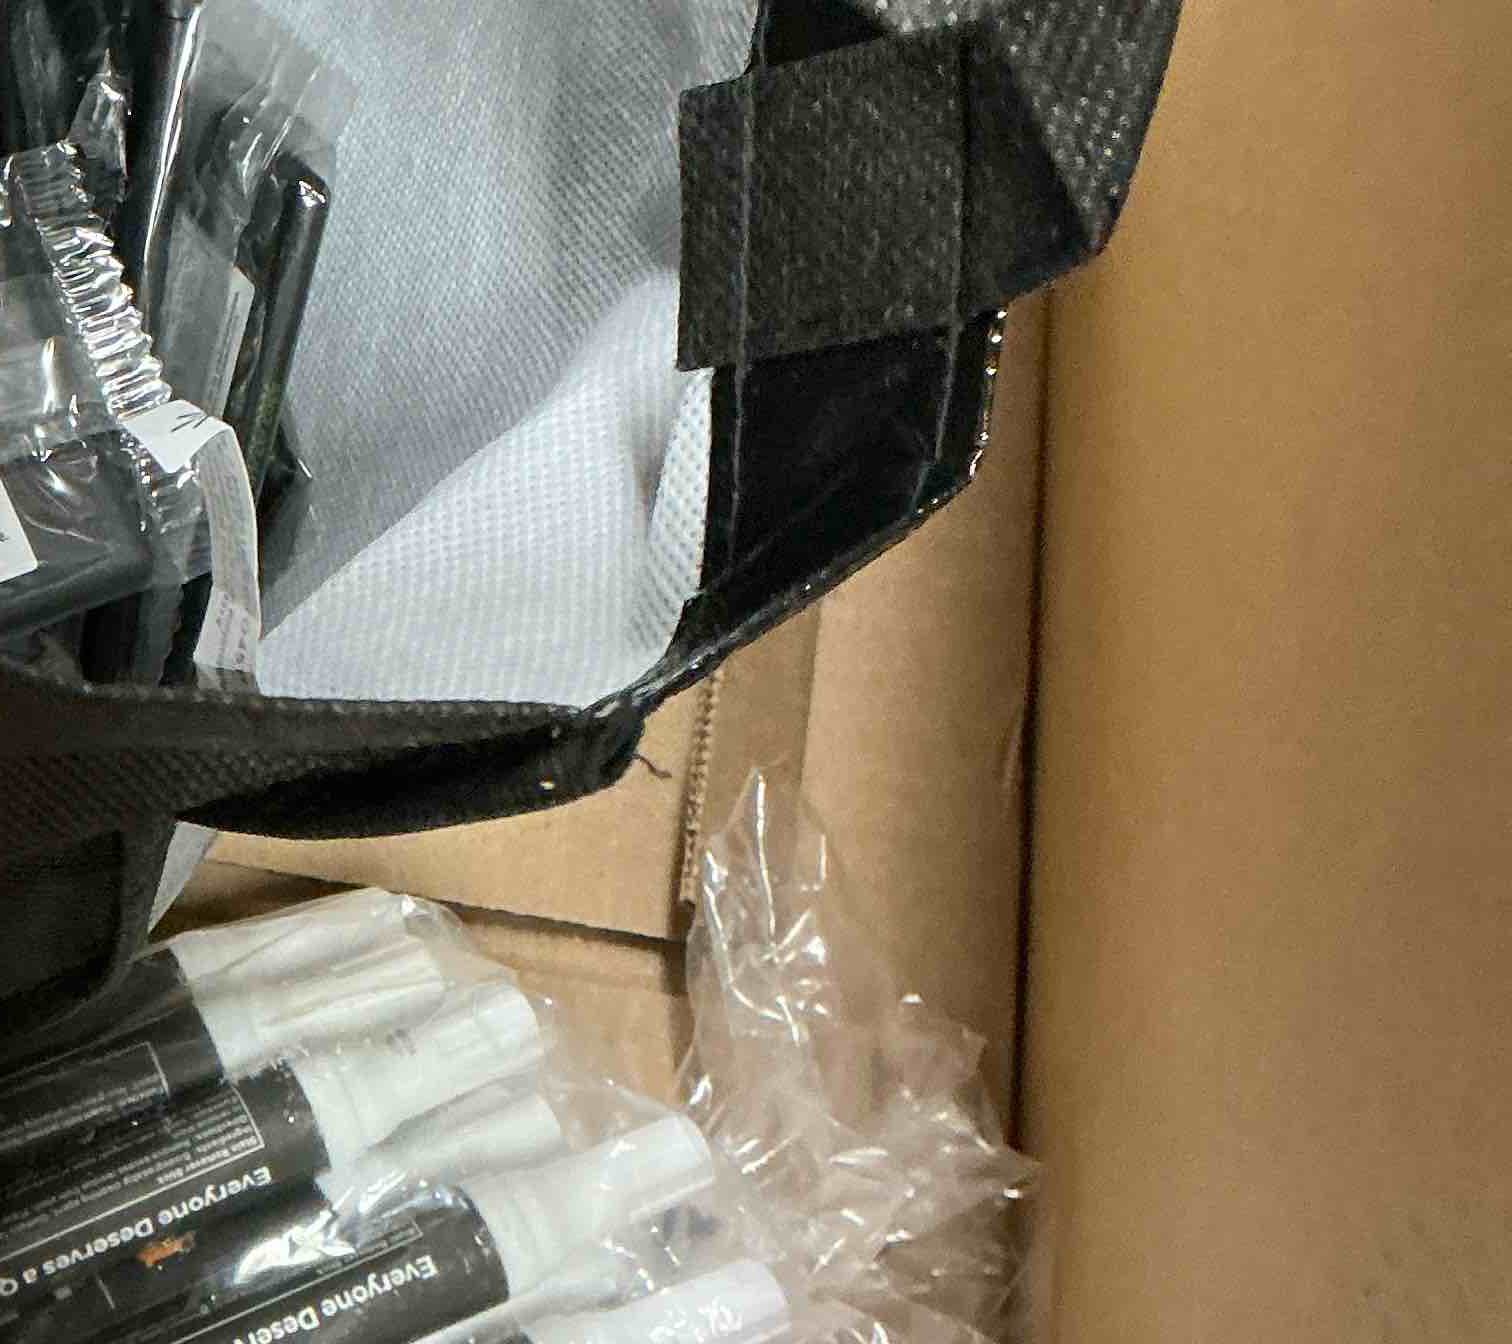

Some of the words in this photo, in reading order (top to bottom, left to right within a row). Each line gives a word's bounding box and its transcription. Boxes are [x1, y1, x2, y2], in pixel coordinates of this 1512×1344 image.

[158, 1165, 272, 1225] Everyone
[42, 1217, 154, 1274] Deserves
[21, 1267, 38, 1284] a
[322, 1255, 438, 1318] Everyone
